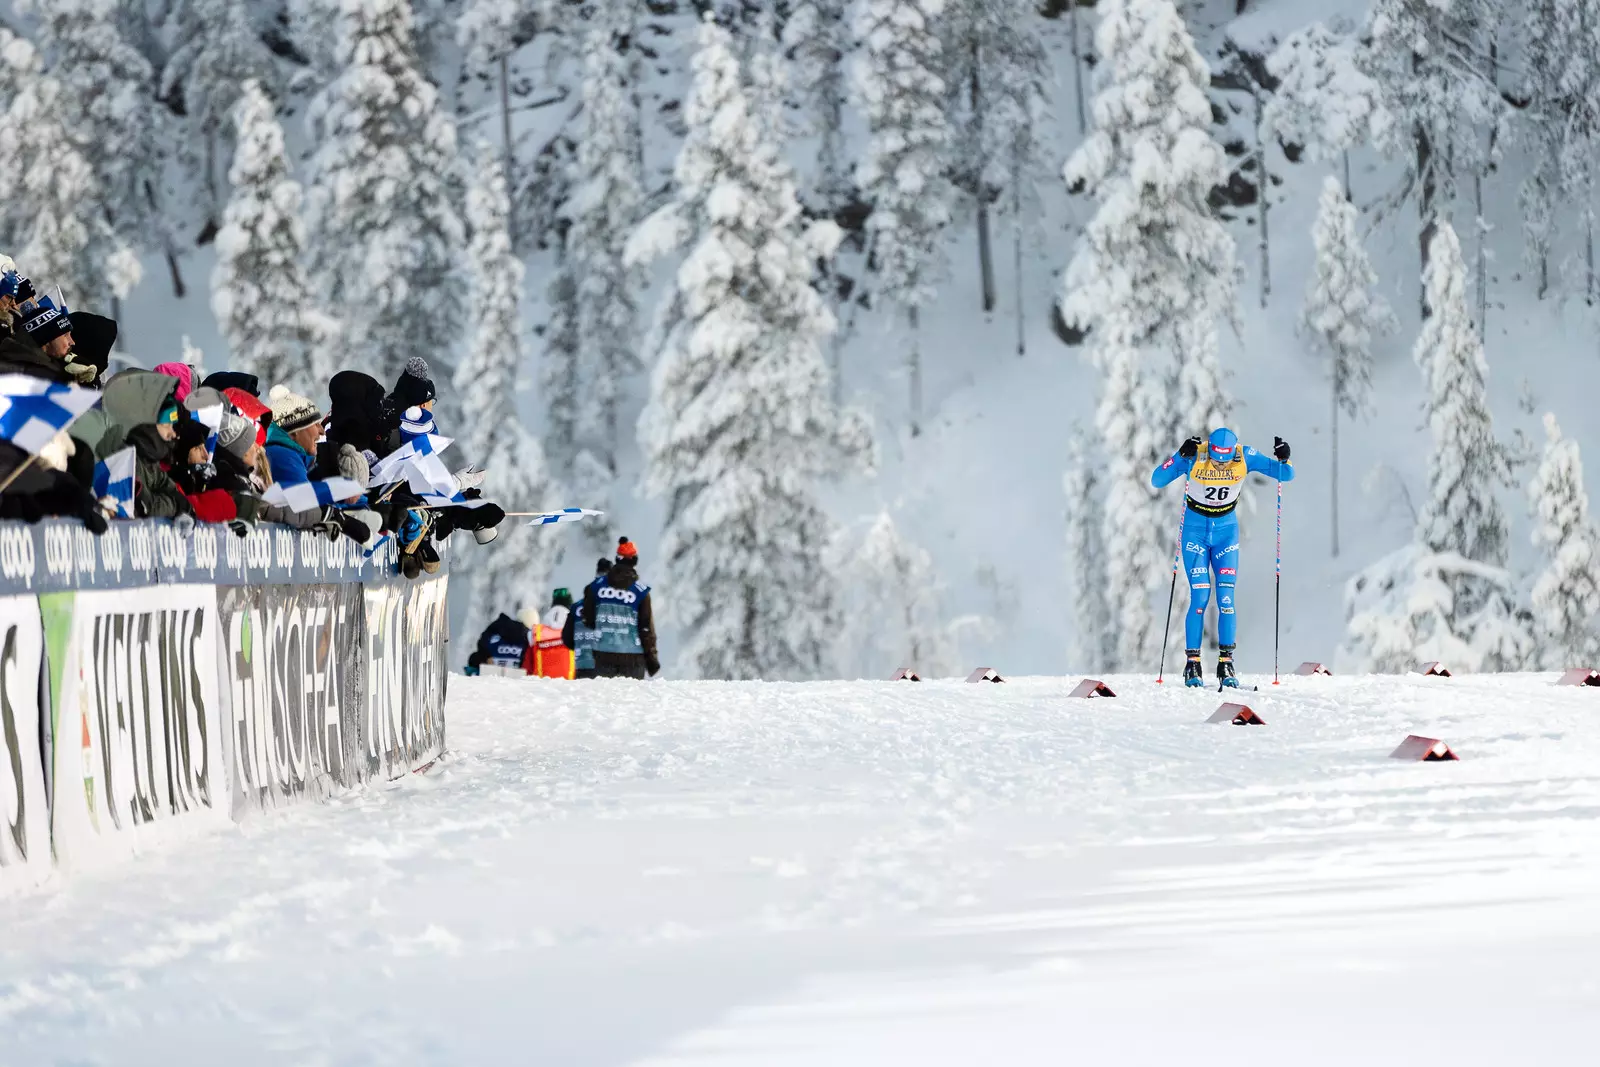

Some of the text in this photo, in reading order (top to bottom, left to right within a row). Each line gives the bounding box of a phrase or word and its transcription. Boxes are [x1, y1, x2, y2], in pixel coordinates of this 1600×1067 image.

[1205, 487, 1230, 501] 26
[1186, 542, 1206, 554] EA7
[1, 525, 35, 590] coop
[45, 524, 73, 586] coop
[129, 525, 151, 582] coop
[194, 526, 217, 579] coop
[247, 528, 271, 579] coop
[276, 528, 294, 577] coop
[598, 587, 636, 603] coop
